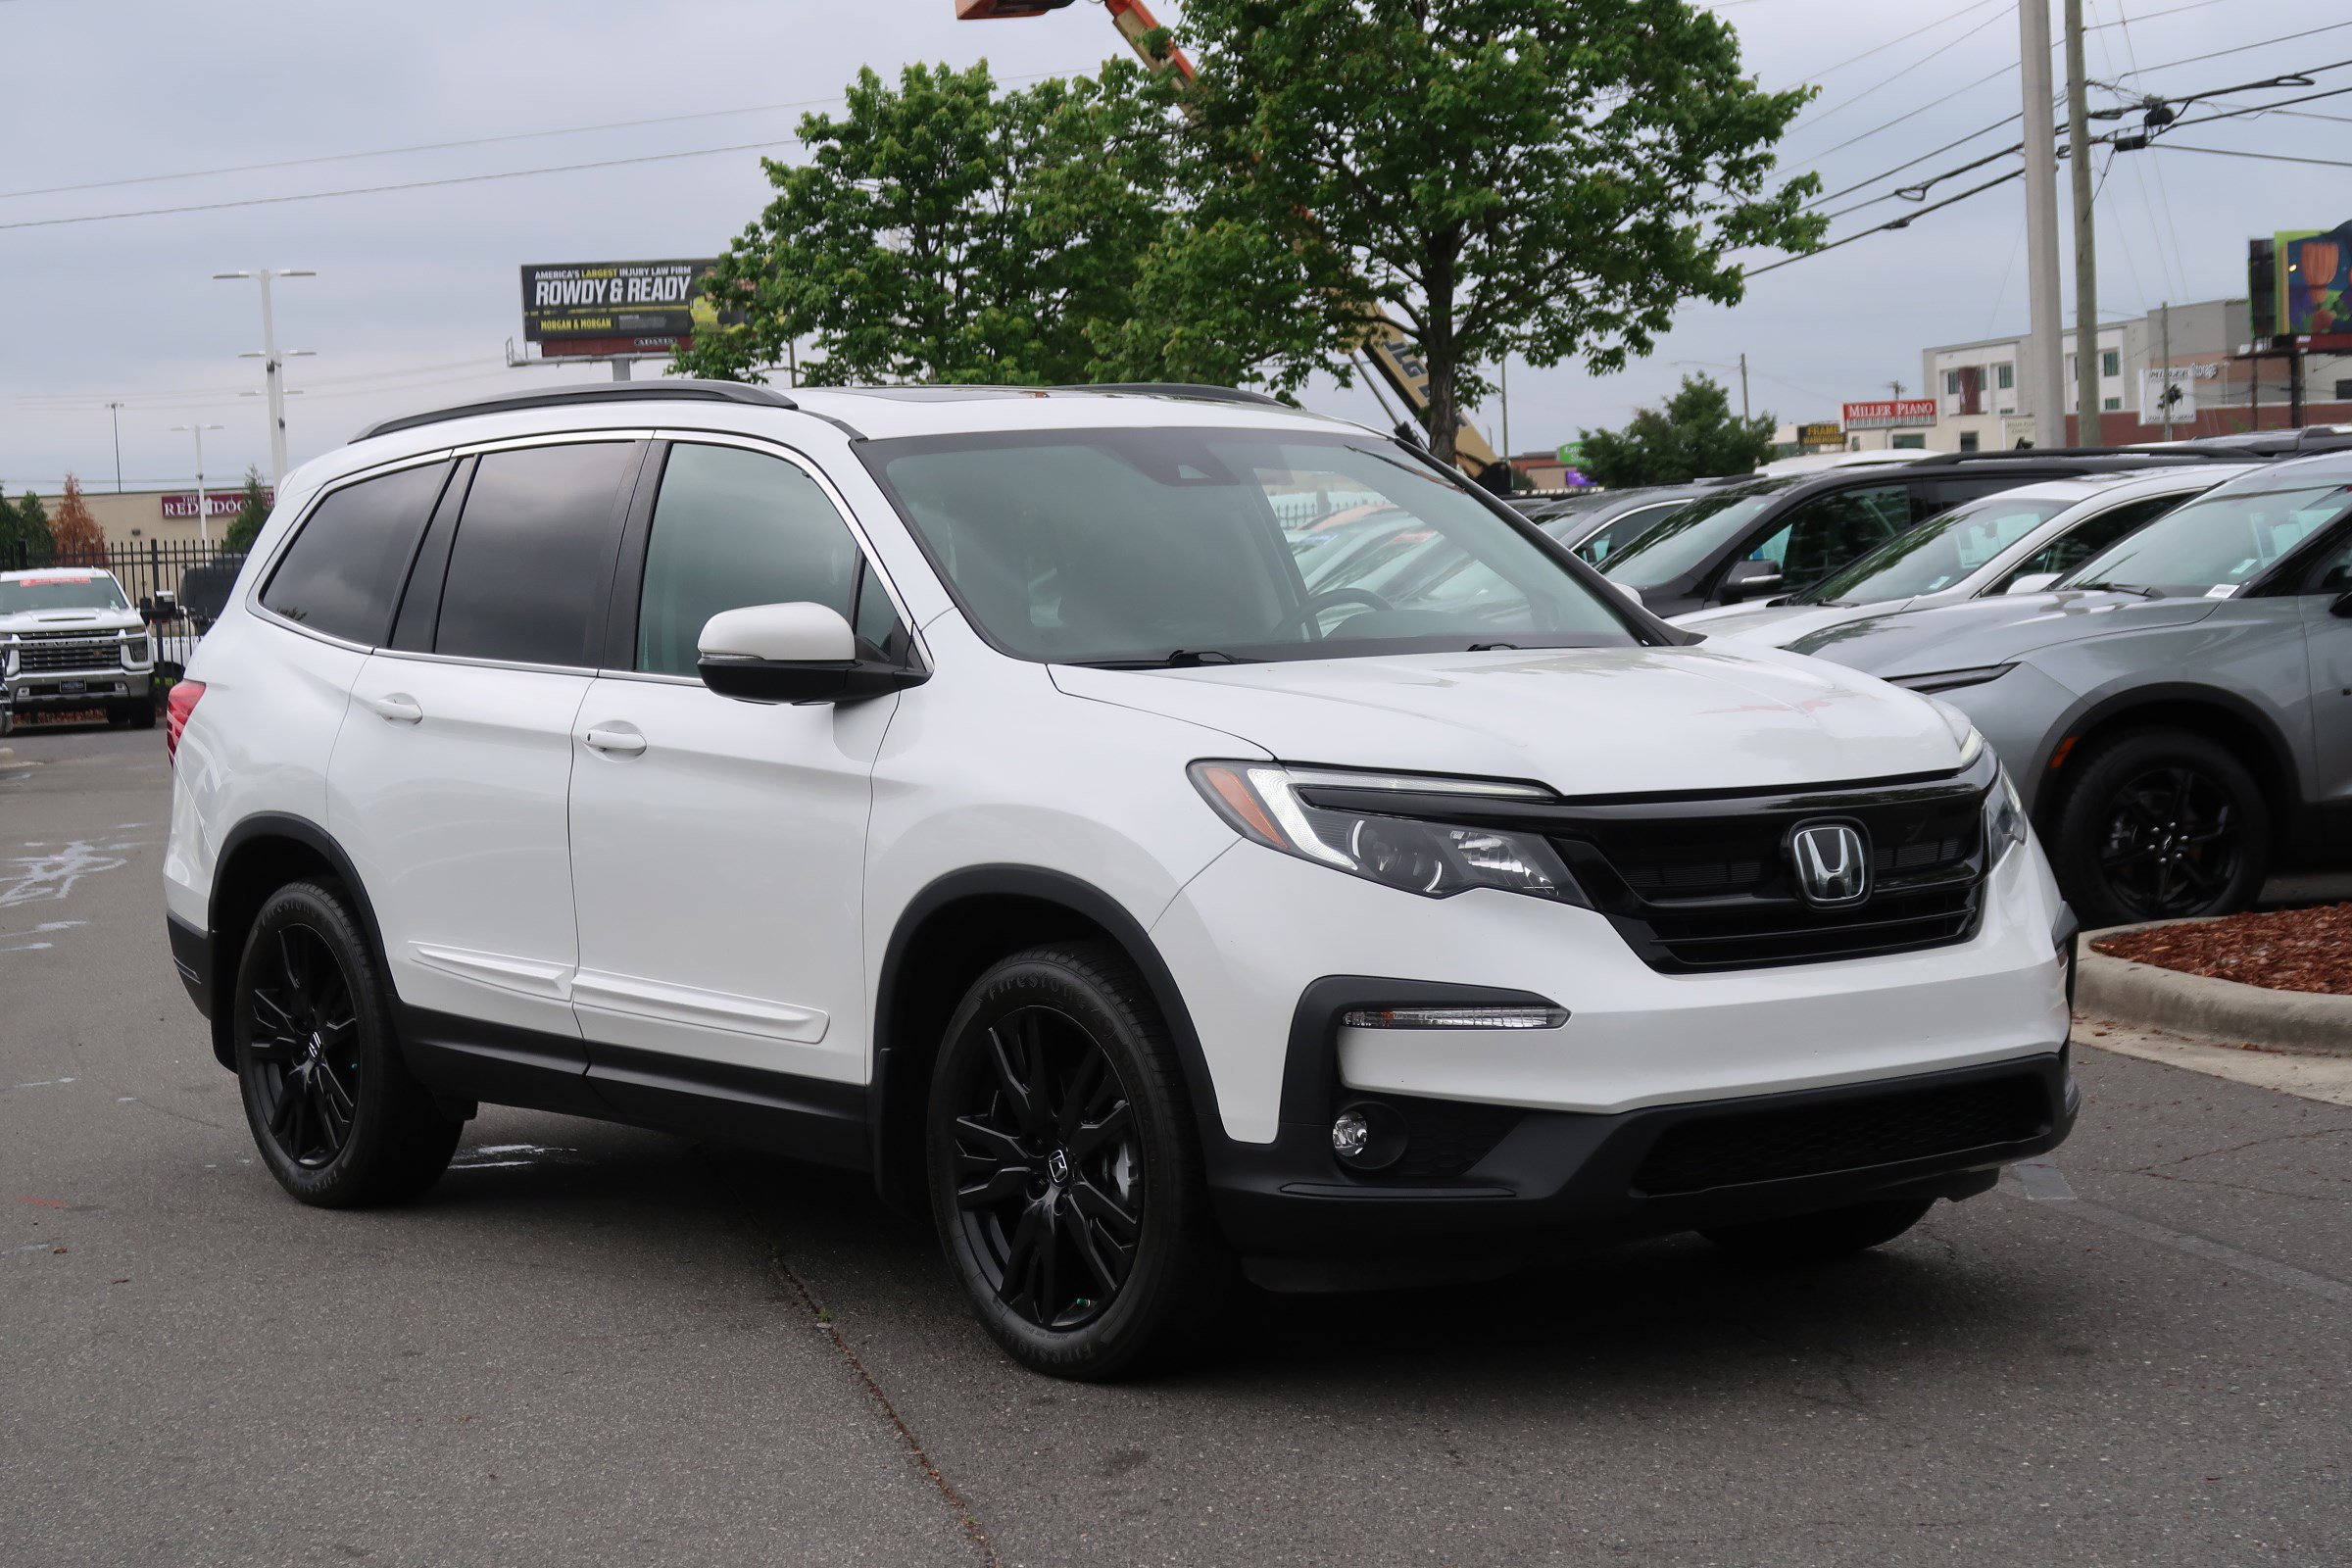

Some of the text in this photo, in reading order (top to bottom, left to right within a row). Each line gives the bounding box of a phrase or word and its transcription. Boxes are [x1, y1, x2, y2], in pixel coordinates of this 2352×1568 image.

[535, 266, 692, 280] AMERICA'S LARGEST INJURY LAW FIRM
[535, 275, 692, 306] ROWDY & READY
[540, 319, 571, 331] MORGAN
[573, 318, 579, 329] &
[581, 318, 612, 329] MORGAN
[1849, 402, 1934, 417] MILLER PIANO
[1807, 424, 1838, 435] FRAME
[183, 495, 197, 504] THE
[164, 502, 199, 516] RED
[214, 498, 251, 514] DOO
